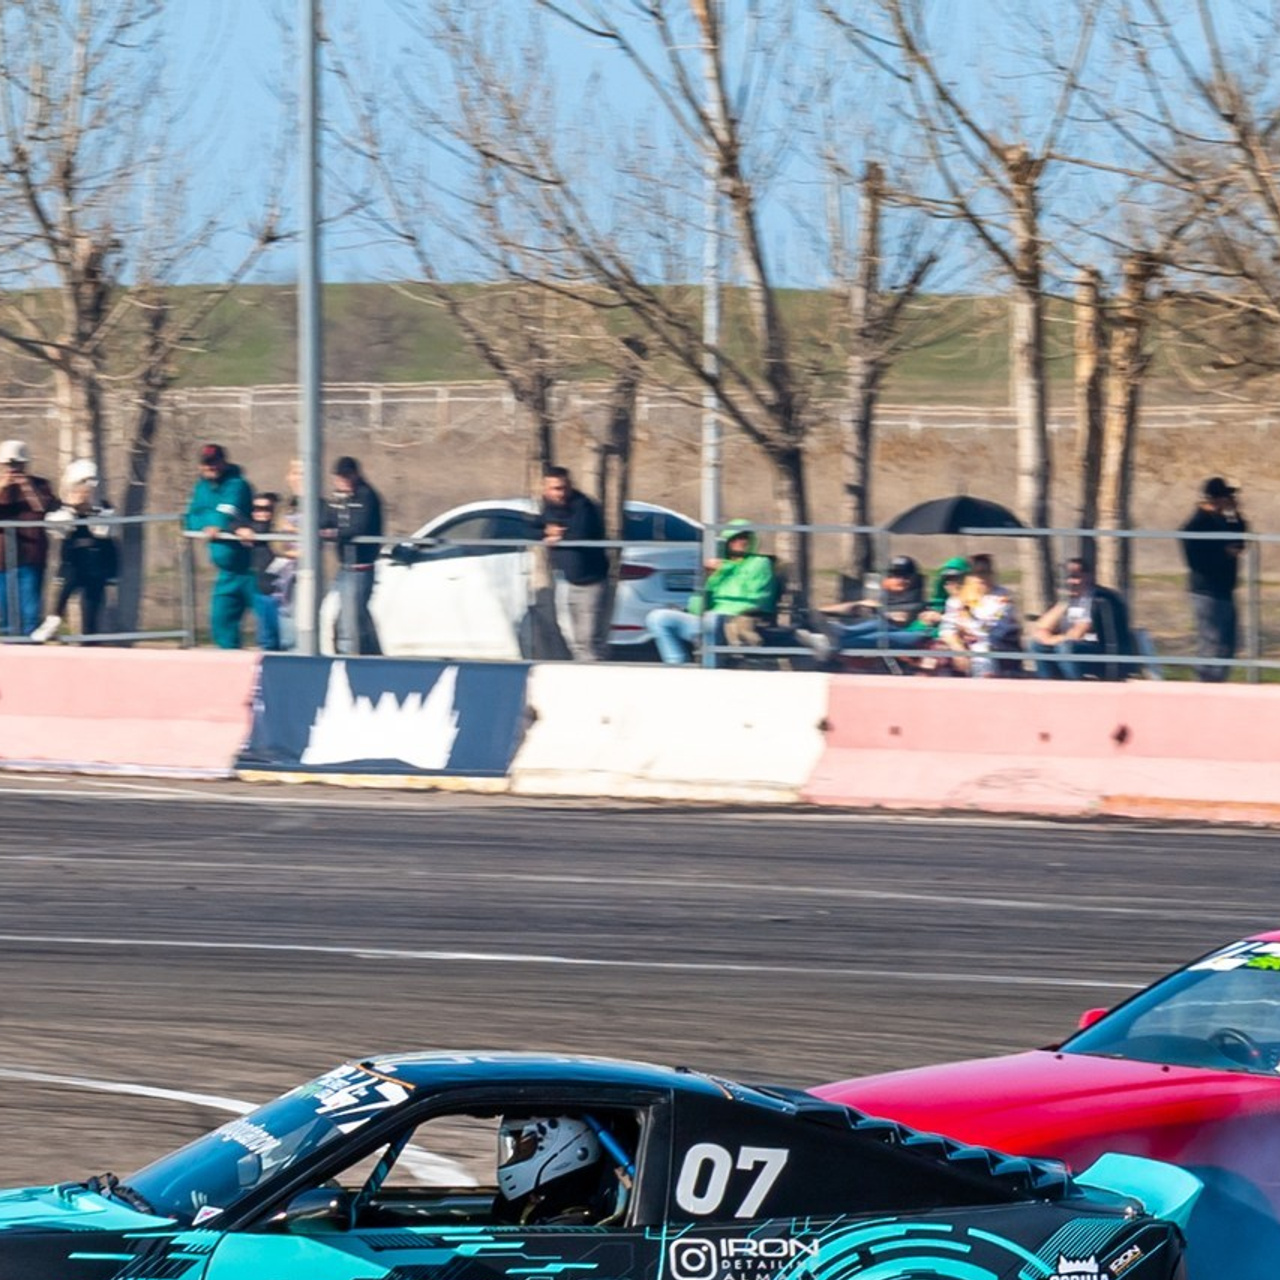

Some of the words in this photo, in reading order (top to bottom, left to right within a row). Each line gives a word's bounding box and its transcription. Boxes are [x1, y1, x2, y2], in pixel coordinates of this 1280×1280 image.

[676, 1142, 789, 1218] 07
[720, 1238, 820, 1257] IRON
[721, 1259, 819, 1270] DETAILIN
